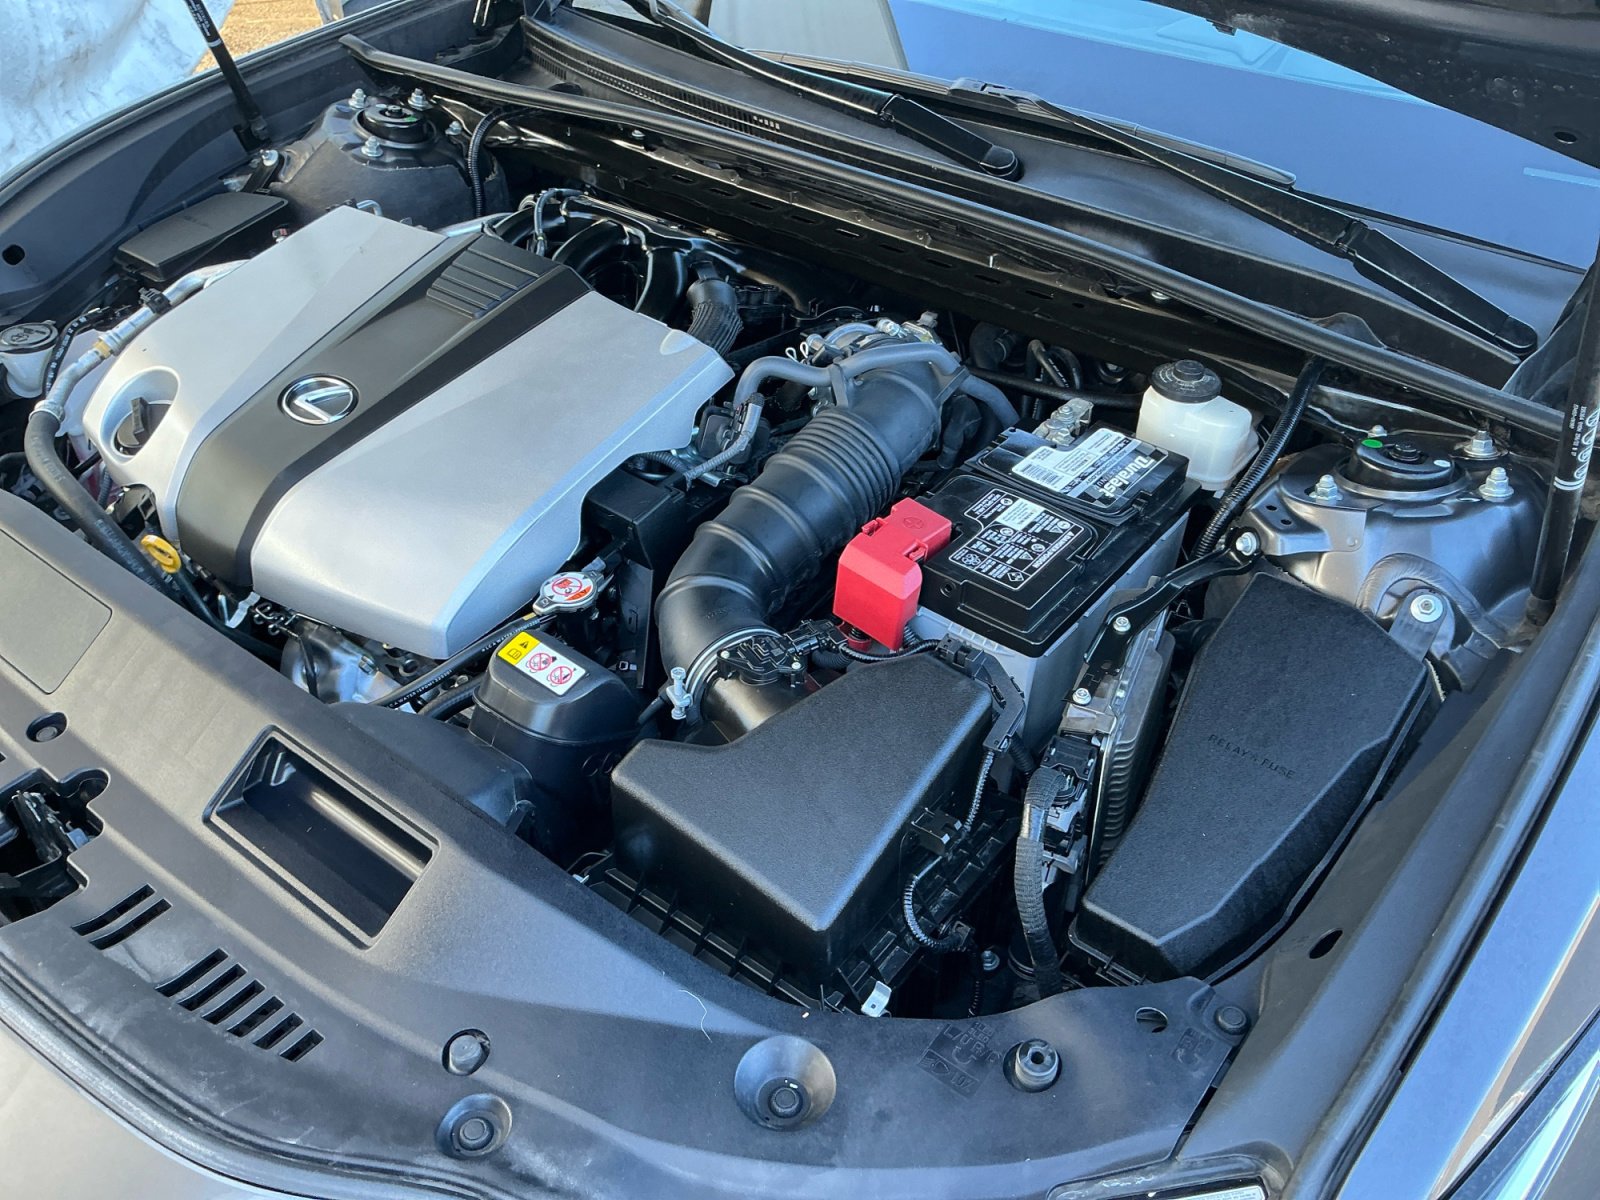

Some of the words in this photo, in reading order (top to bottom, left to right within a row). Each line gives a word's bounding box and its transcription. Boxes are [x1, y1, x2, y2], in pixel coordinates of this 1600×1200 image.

[1099, 456, 1155, 498] Duralast
[1208, 734, 1250, 756] RELAY
[1260, 758, 1296, 779] FUSE
